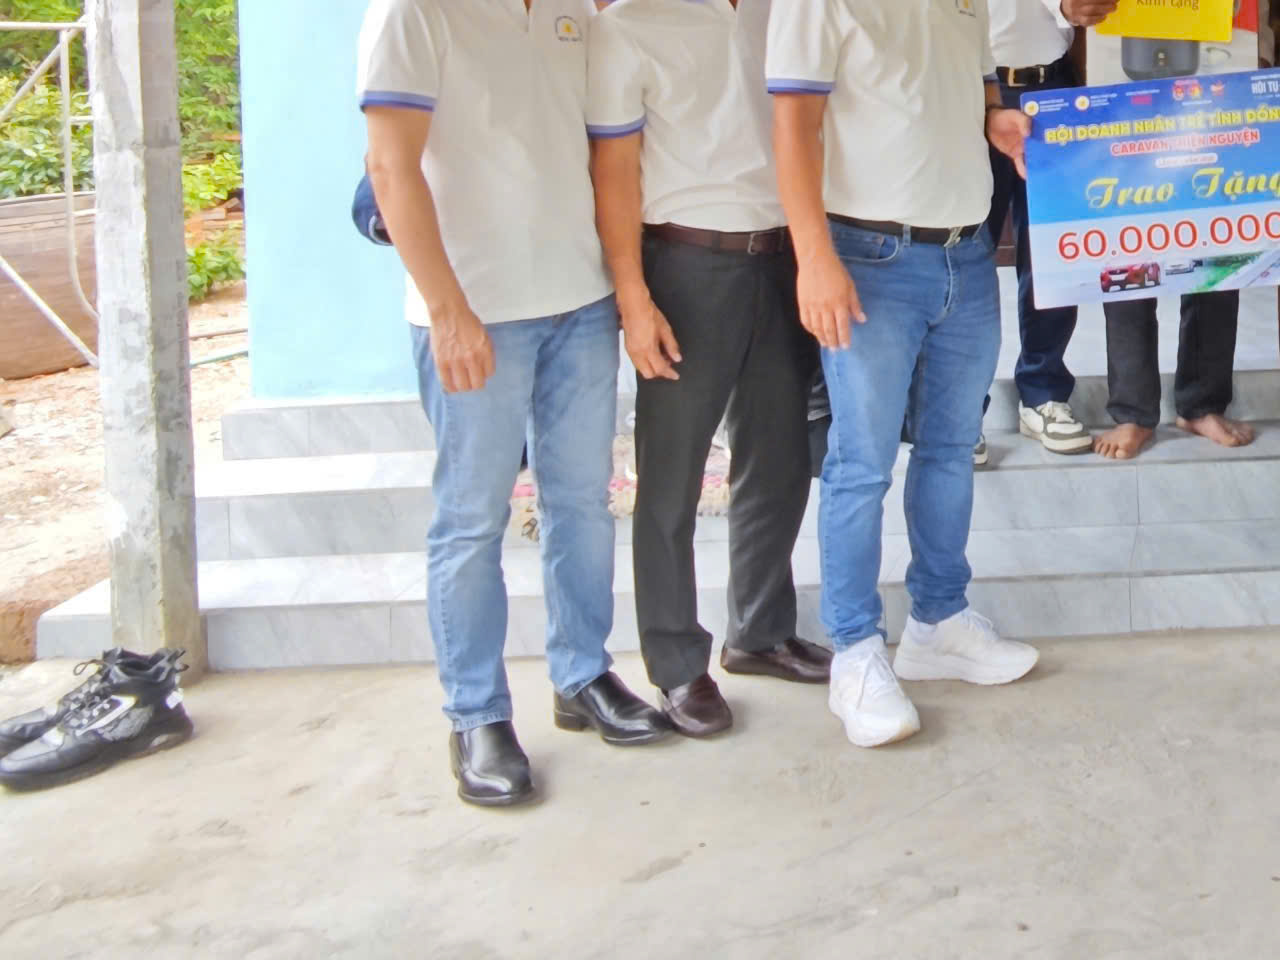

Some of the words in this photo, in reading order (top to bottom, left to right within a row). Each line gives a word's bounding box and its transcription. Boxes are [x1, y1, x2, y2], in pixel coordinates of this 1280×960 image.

[1045, 124, 1074, 146] HỘI
[1075, 122, 1131, 141] DOANH
[1133, 114, 1176, 136] NHÂN
[1208, 127, 1260, 148] NGUYỆN
[1086, 177, 1175, 208] Trao
